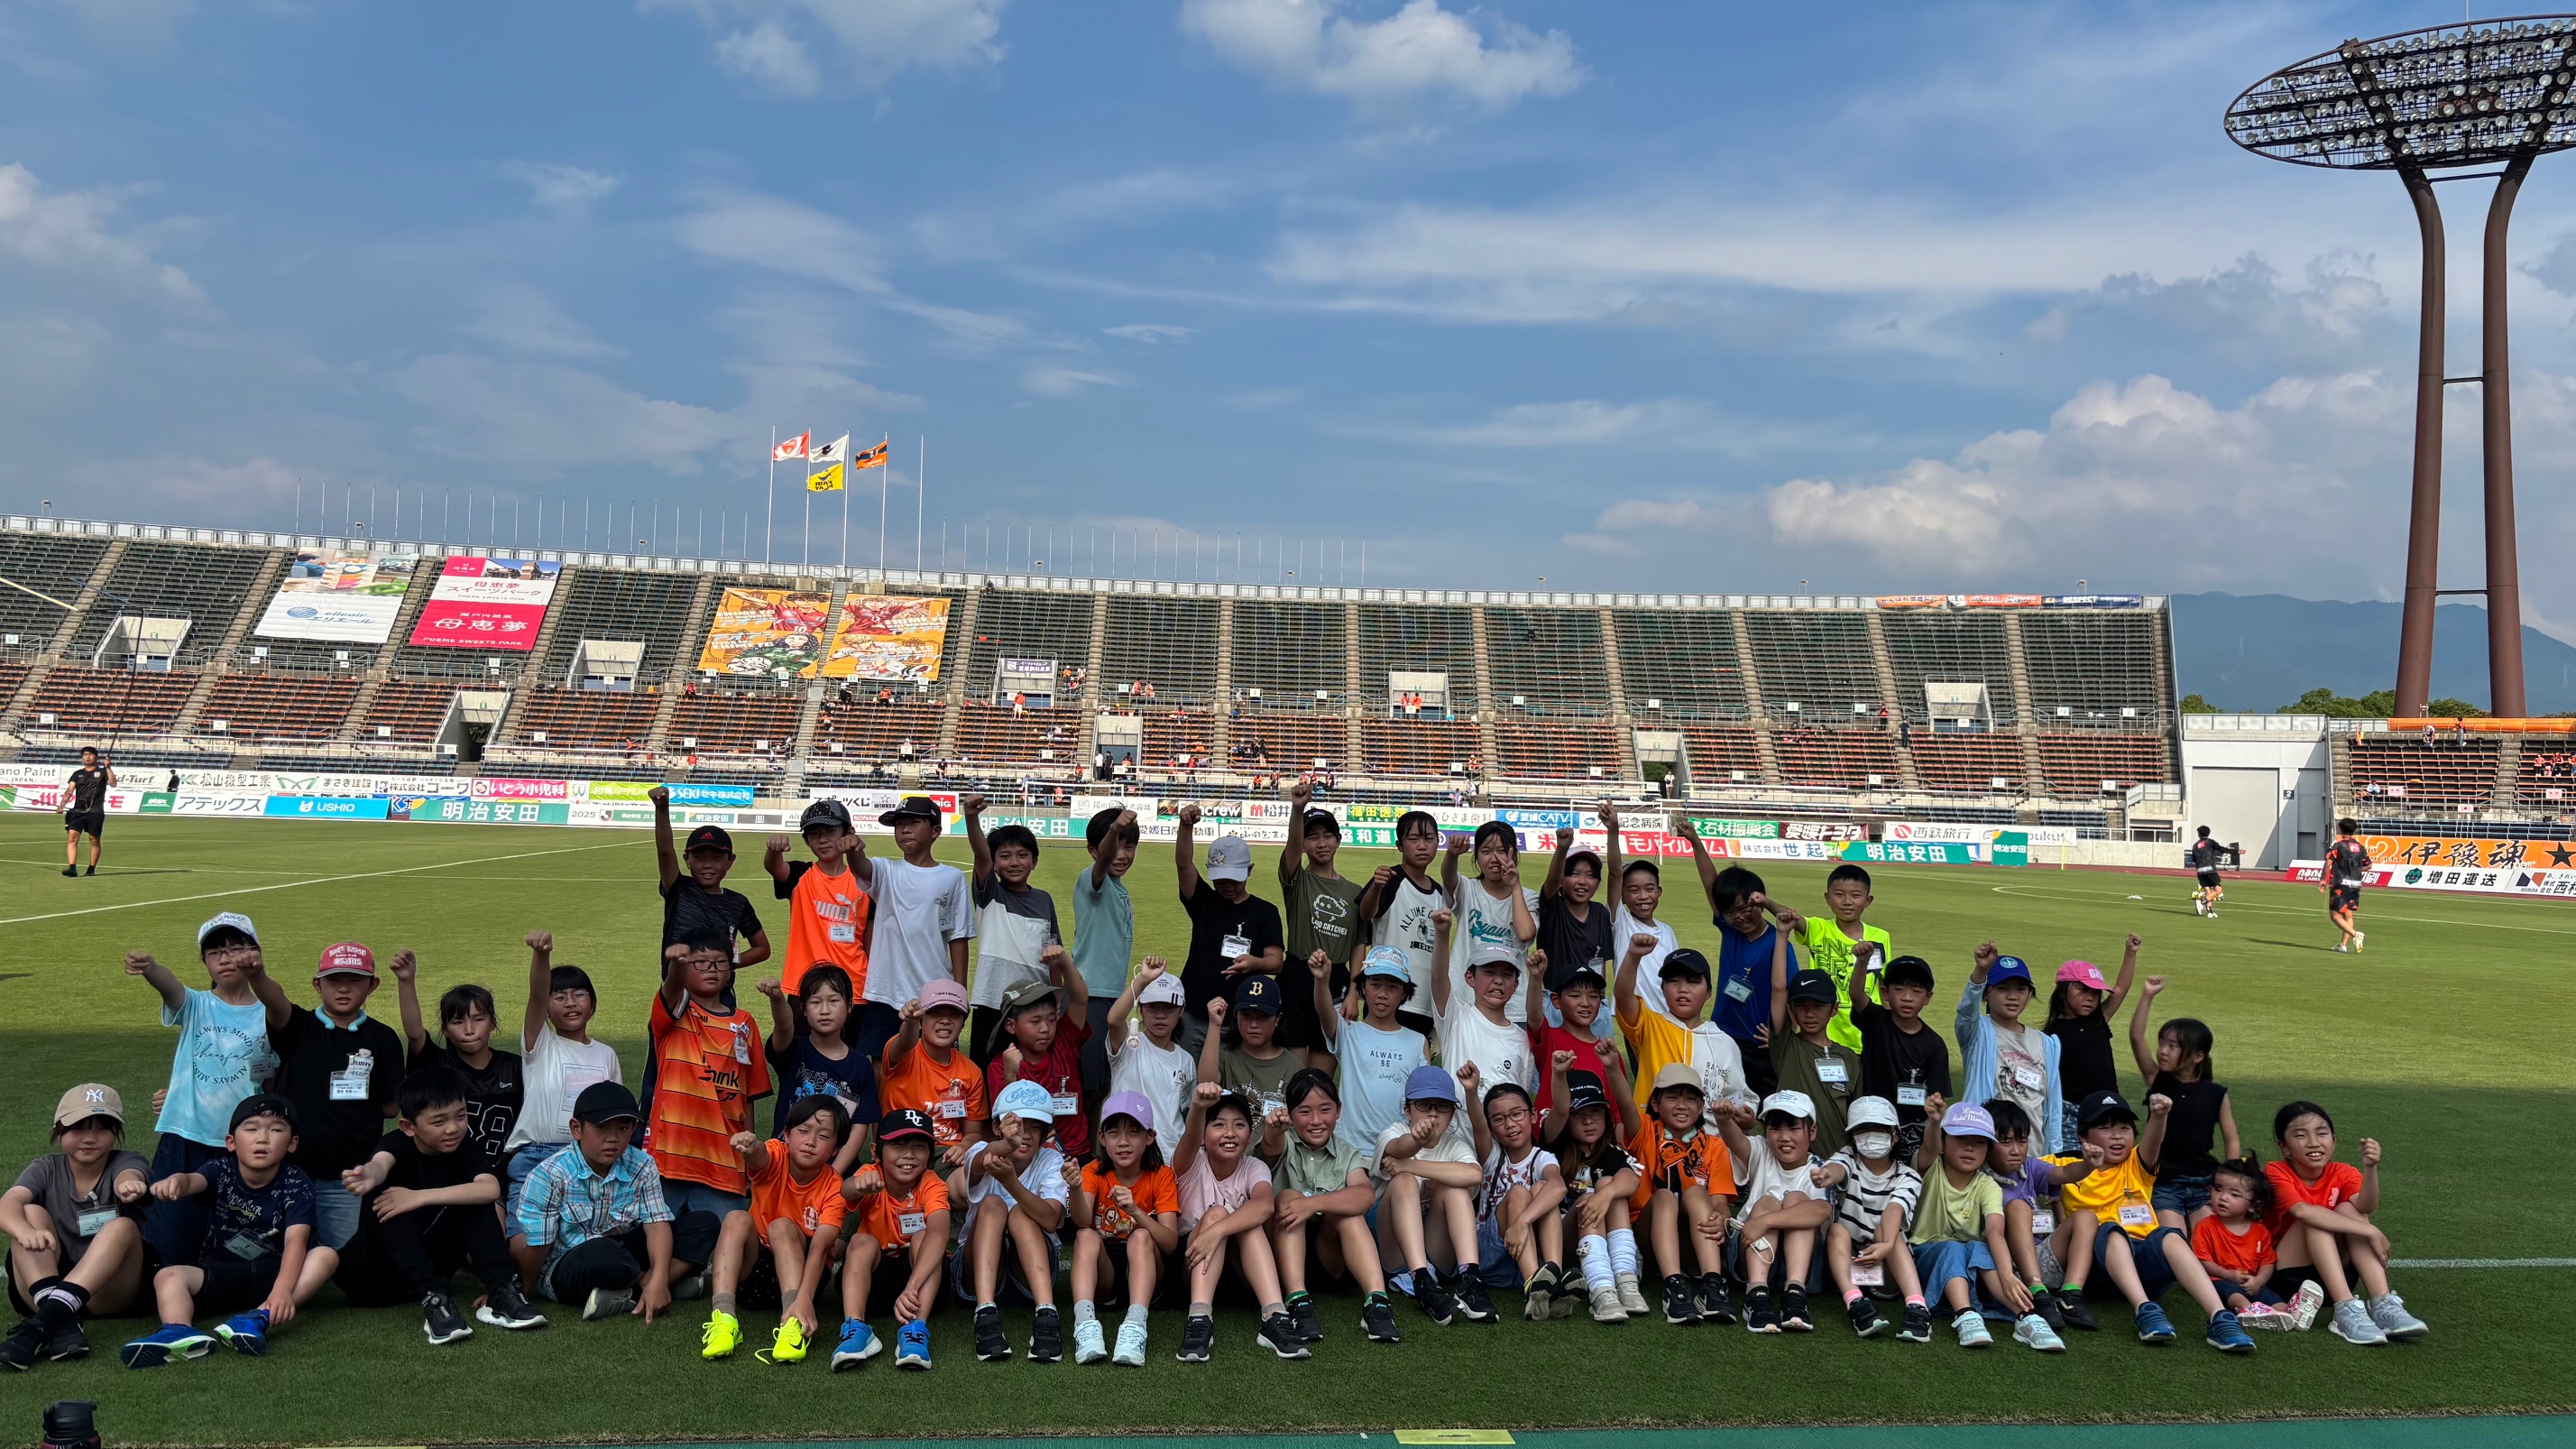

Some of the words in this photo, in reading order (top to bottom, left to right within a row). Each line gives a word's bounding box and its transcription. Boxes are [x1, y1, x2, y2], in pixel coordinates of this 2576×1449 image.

[308, 615, 374, 624] エリエール
[433, 618, 529, 632] 母恵夢
[24, 767, 56, 778] Paint
[323, 779, 371, 788] まさき建設
[390, 782, 425, 792] 株式会社
[427, 782, 470, 795] コーワ
[490, 783, 566, 797] いとう小児科
[676, 788, 699, 800] SEKI
[700, 790, 751, 801] セキ株式会社
[177, 797, 262, 812] アテックス
[317, 802, 354, 812] USHIO
[441, 800, 539, 823] 明治安田
[571, 810, 596, 818] 2025
[695, 813, 729, 822] 明治安田
[1138, 825, 1215, 837] 愛媛日産動車
[1785, 822, 1863, 842] 愛媛トヨタ
[1913, 826, 1972, 839] 西鉄旅行
[1743, 844, 1782, 857] 株式会社
[1783, 844, 1824, 859] 世起
[1865, 842, 1947, 863] 明治安田
[1992, 844, 2028, 853] 明治安田
[2426, 870, 2498, 888] 増田運送
[195, 1025, 228, 1041] ALWAYS
[230, 1028, 253, 1048] MIND
[1369, 1049, 1403, 1061] ALWAYS
[1380, 1059, 1391, 1067] BE
